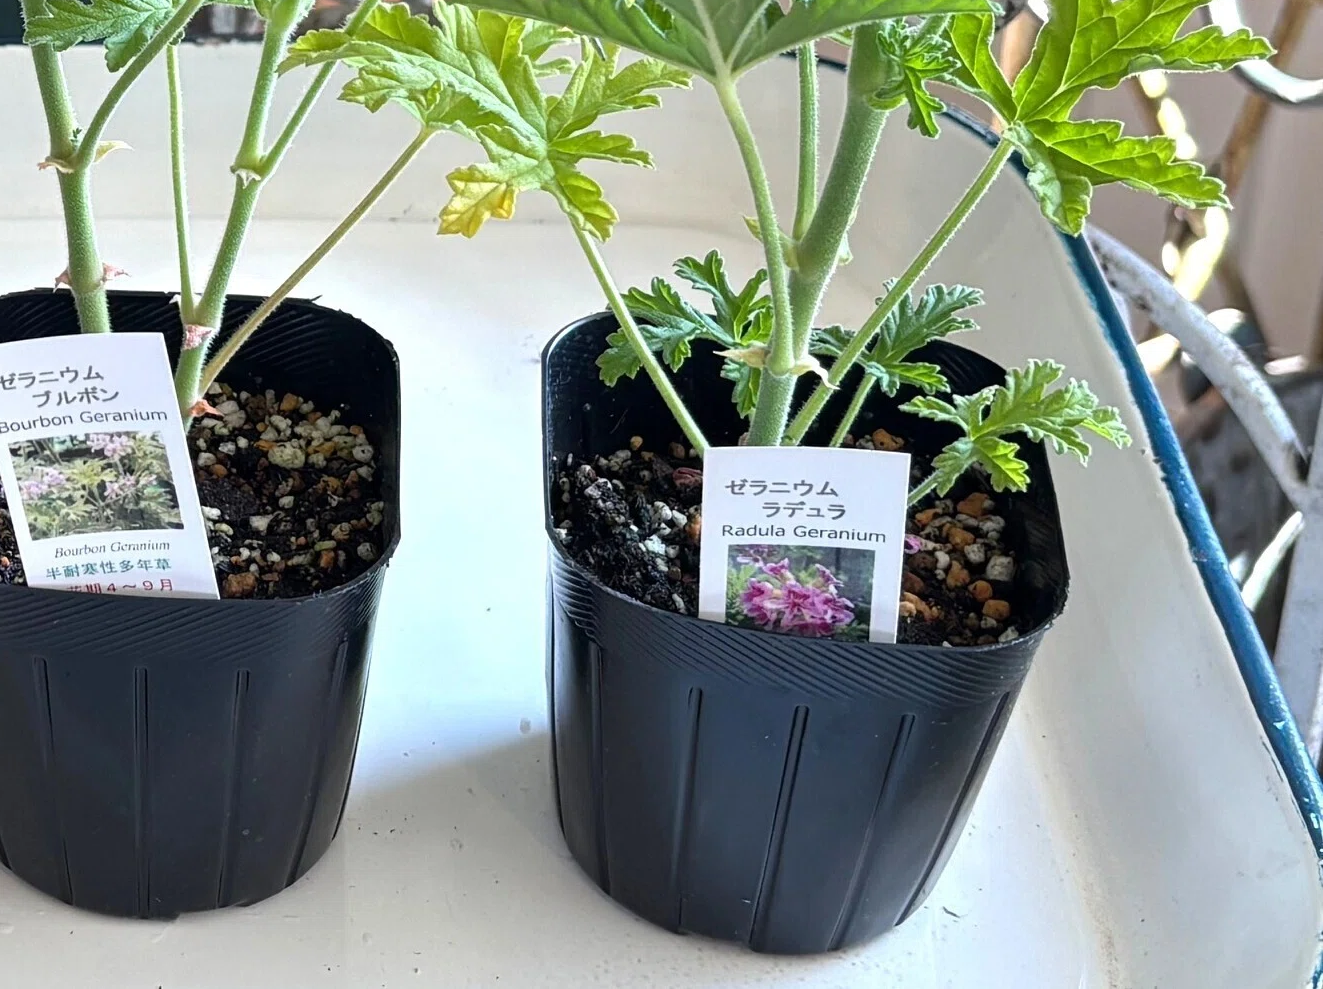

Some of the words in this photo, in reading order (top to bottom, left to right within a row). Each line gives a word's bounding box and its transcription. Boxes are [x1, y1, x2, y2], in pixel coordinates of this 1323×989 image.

[32, 386, 120, 408] ブルボン
[79, 408, 168, 423] Geranium
[725, 478, 839, 497] ゼラニウム
[762, 501, 846, 520] ラデュラ
[722, 524, 785, 538] Radula
[793, 525, 886, 543] Geranium
[54, 543, 106, 559] Bourbon
[110, 539, 170, 553] Geranium
[46, 558, 172, 580] 半耐寒性多年草
